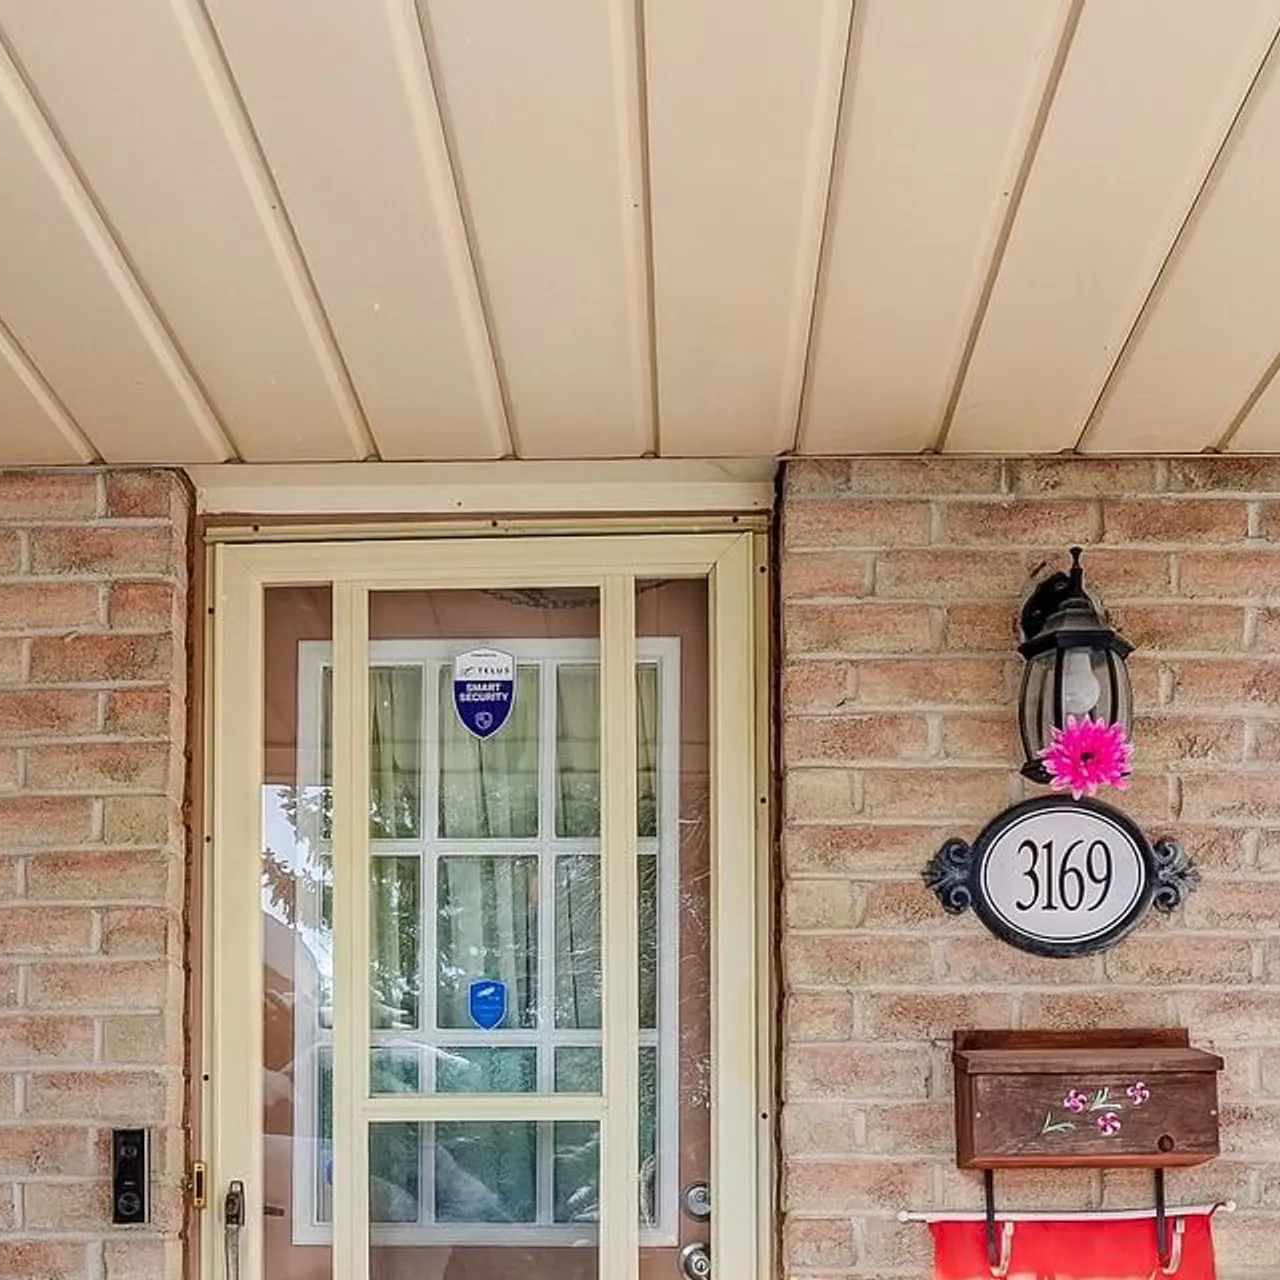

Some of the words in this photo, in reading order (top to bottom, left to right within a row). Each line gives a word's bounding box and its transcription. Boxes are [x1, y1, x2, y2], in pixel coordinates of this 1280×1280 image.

[465, 683, 501, 692] SMART
[459, 692, 509, 702] SECURITY
[1015, 839, 1113, 912] 3169
